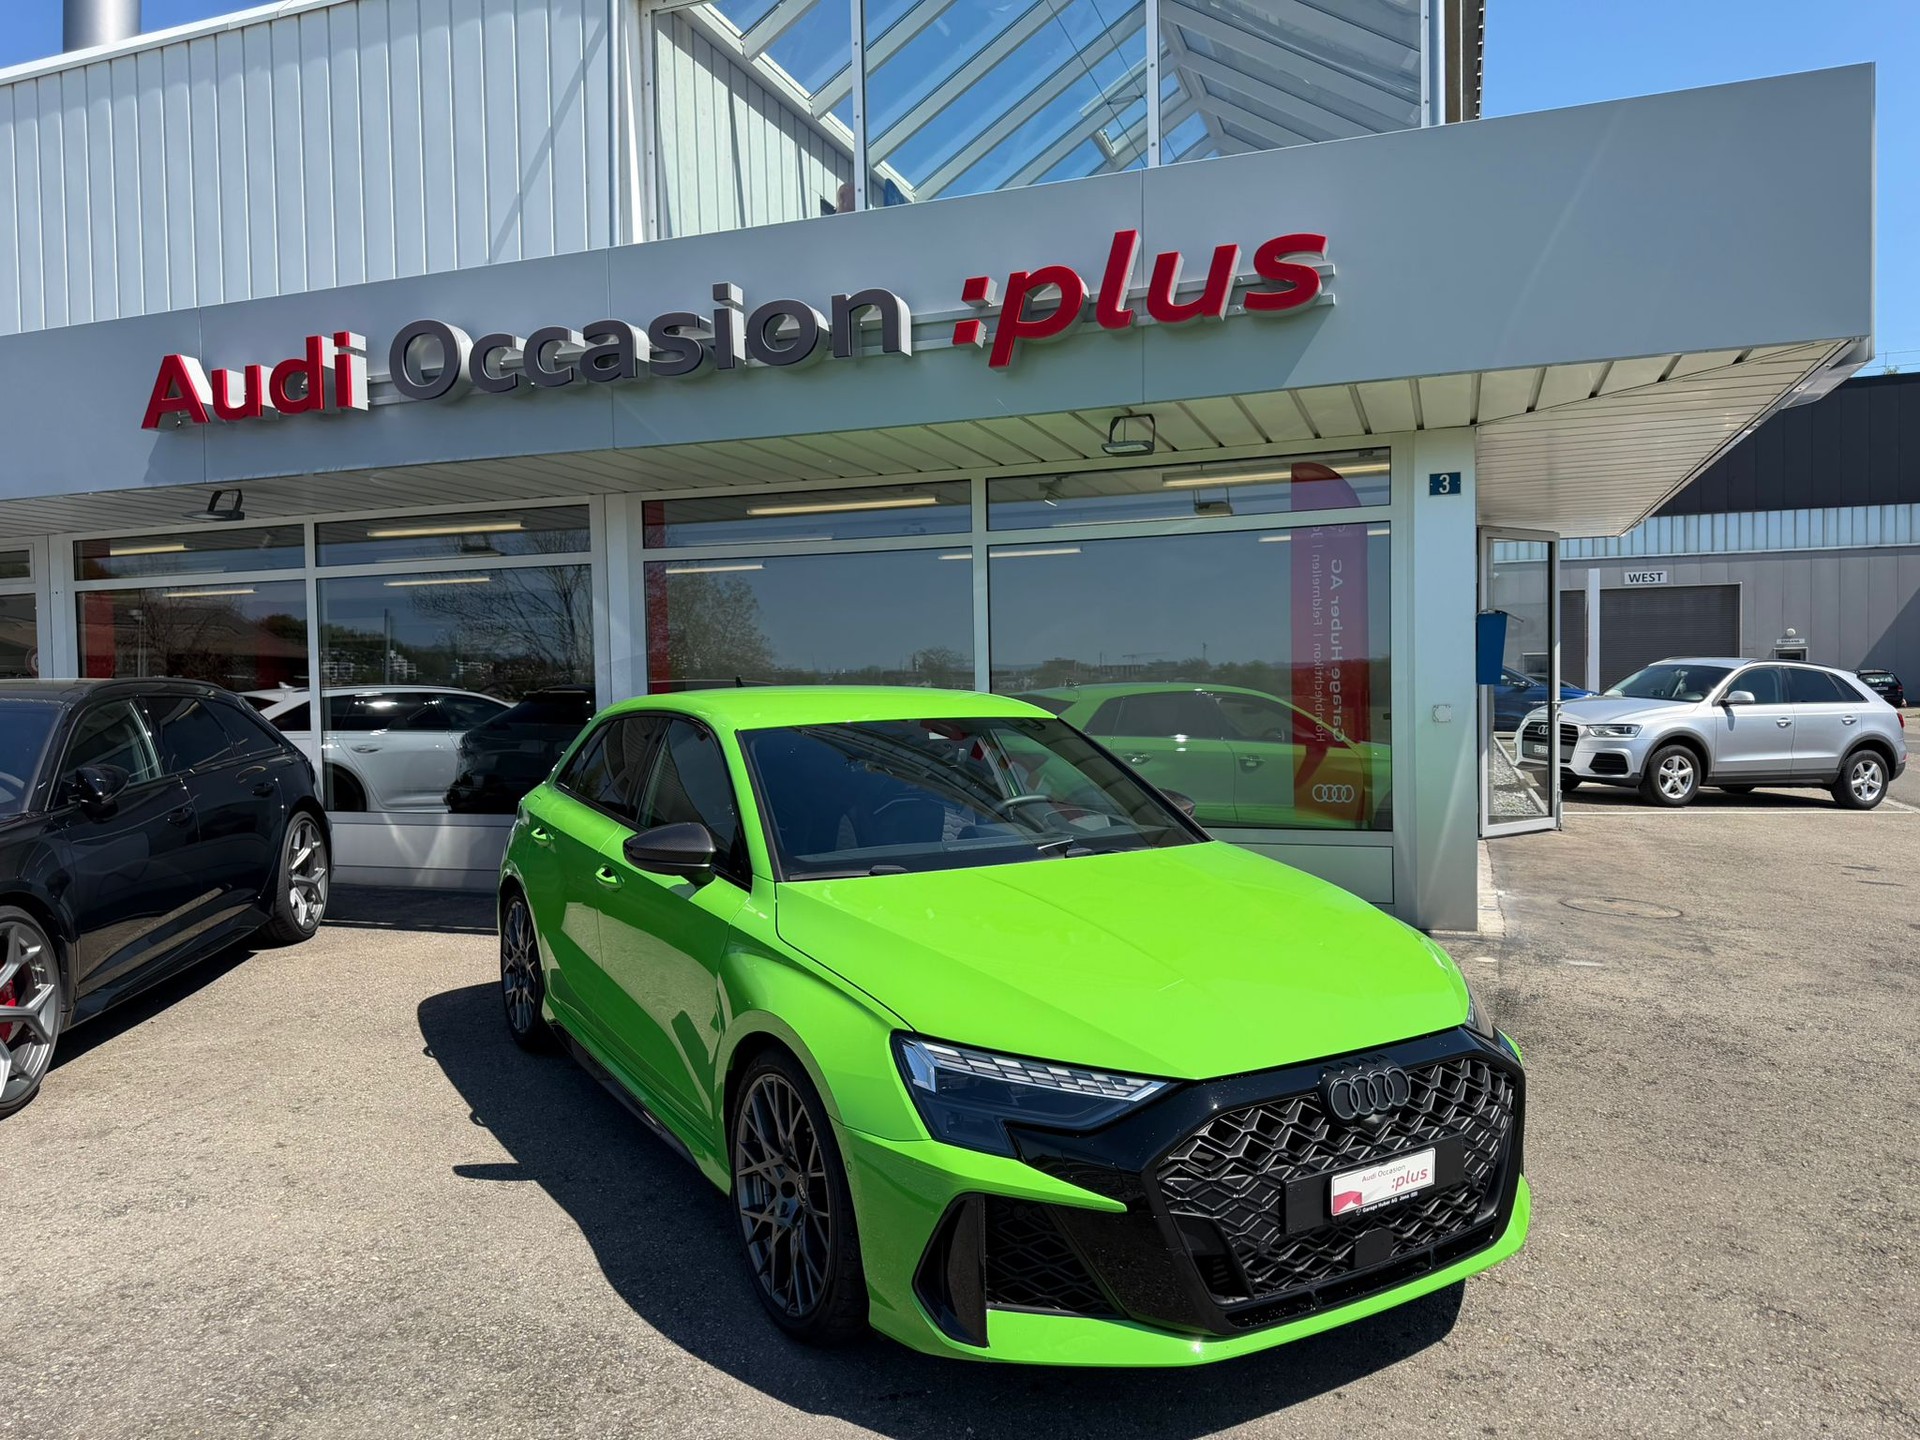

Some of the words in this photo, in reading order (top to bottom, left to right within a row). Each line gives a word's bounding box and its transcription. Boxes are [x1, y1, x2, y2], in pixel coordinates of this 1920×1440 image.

[141, 331, 362, 430] Audi
[389, 282, 908, 400] Occasion
[952, 229, 1328, 368] :plus
[1439, 474, 1450, 493] 3
[1628, 572, 1663, 583] WEST
[1362, 1173, 1376, 1182] Audi
[1378, 1165, 1406, 1178] Occasion
[1392, 1168, 1428, 1191] :plus
[1378, 1200, 1390, 1208] Huber
